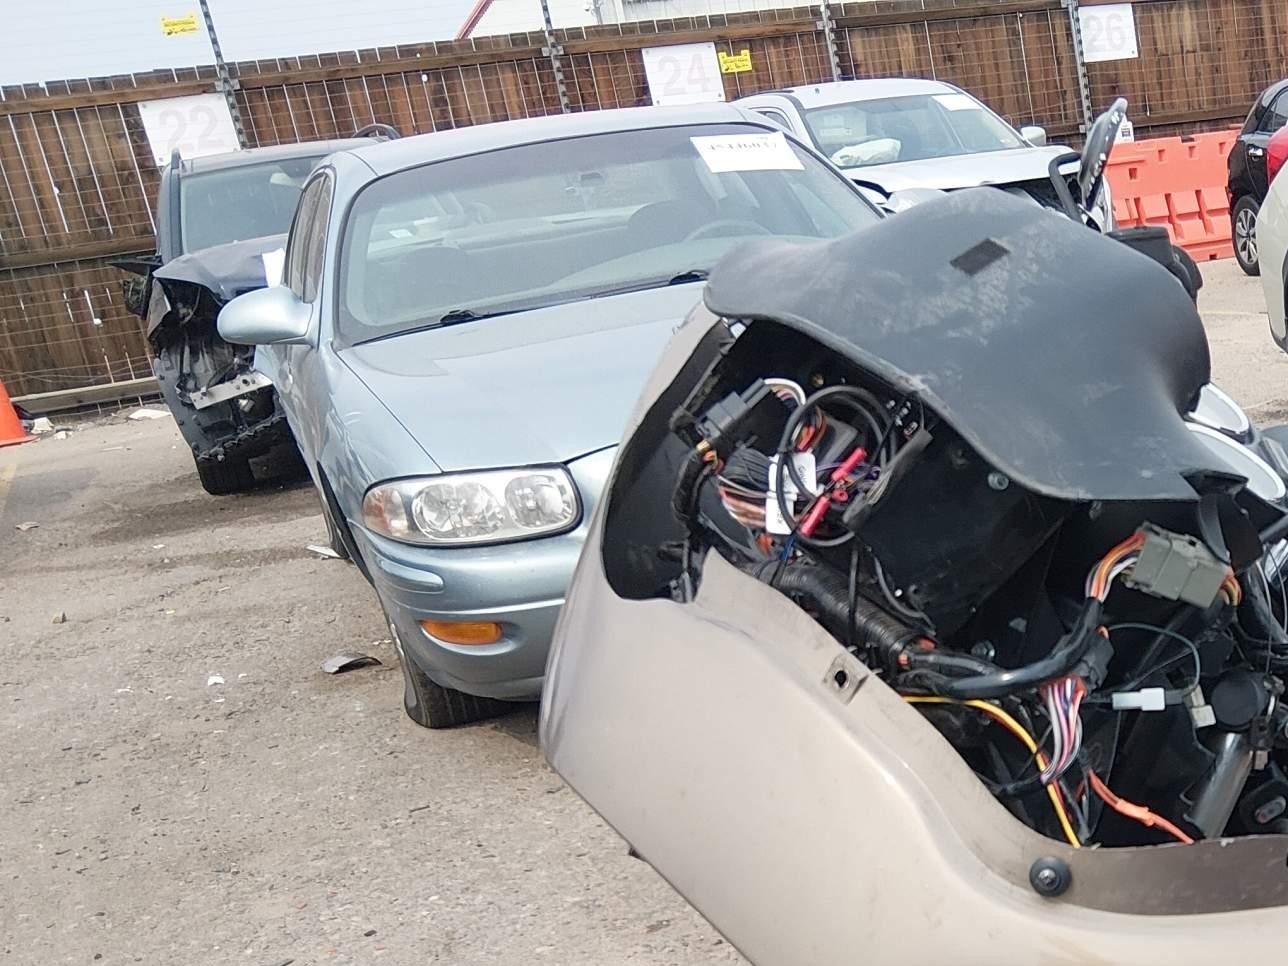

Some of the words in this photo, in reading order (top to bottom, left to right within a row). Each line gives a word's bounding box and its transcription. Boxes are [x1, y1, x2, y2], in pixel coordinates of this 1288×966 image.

[1084, 13, 1127, 52] 26
[658, 53, 716, 96] 24
[159, 104, 226, 155] 22
